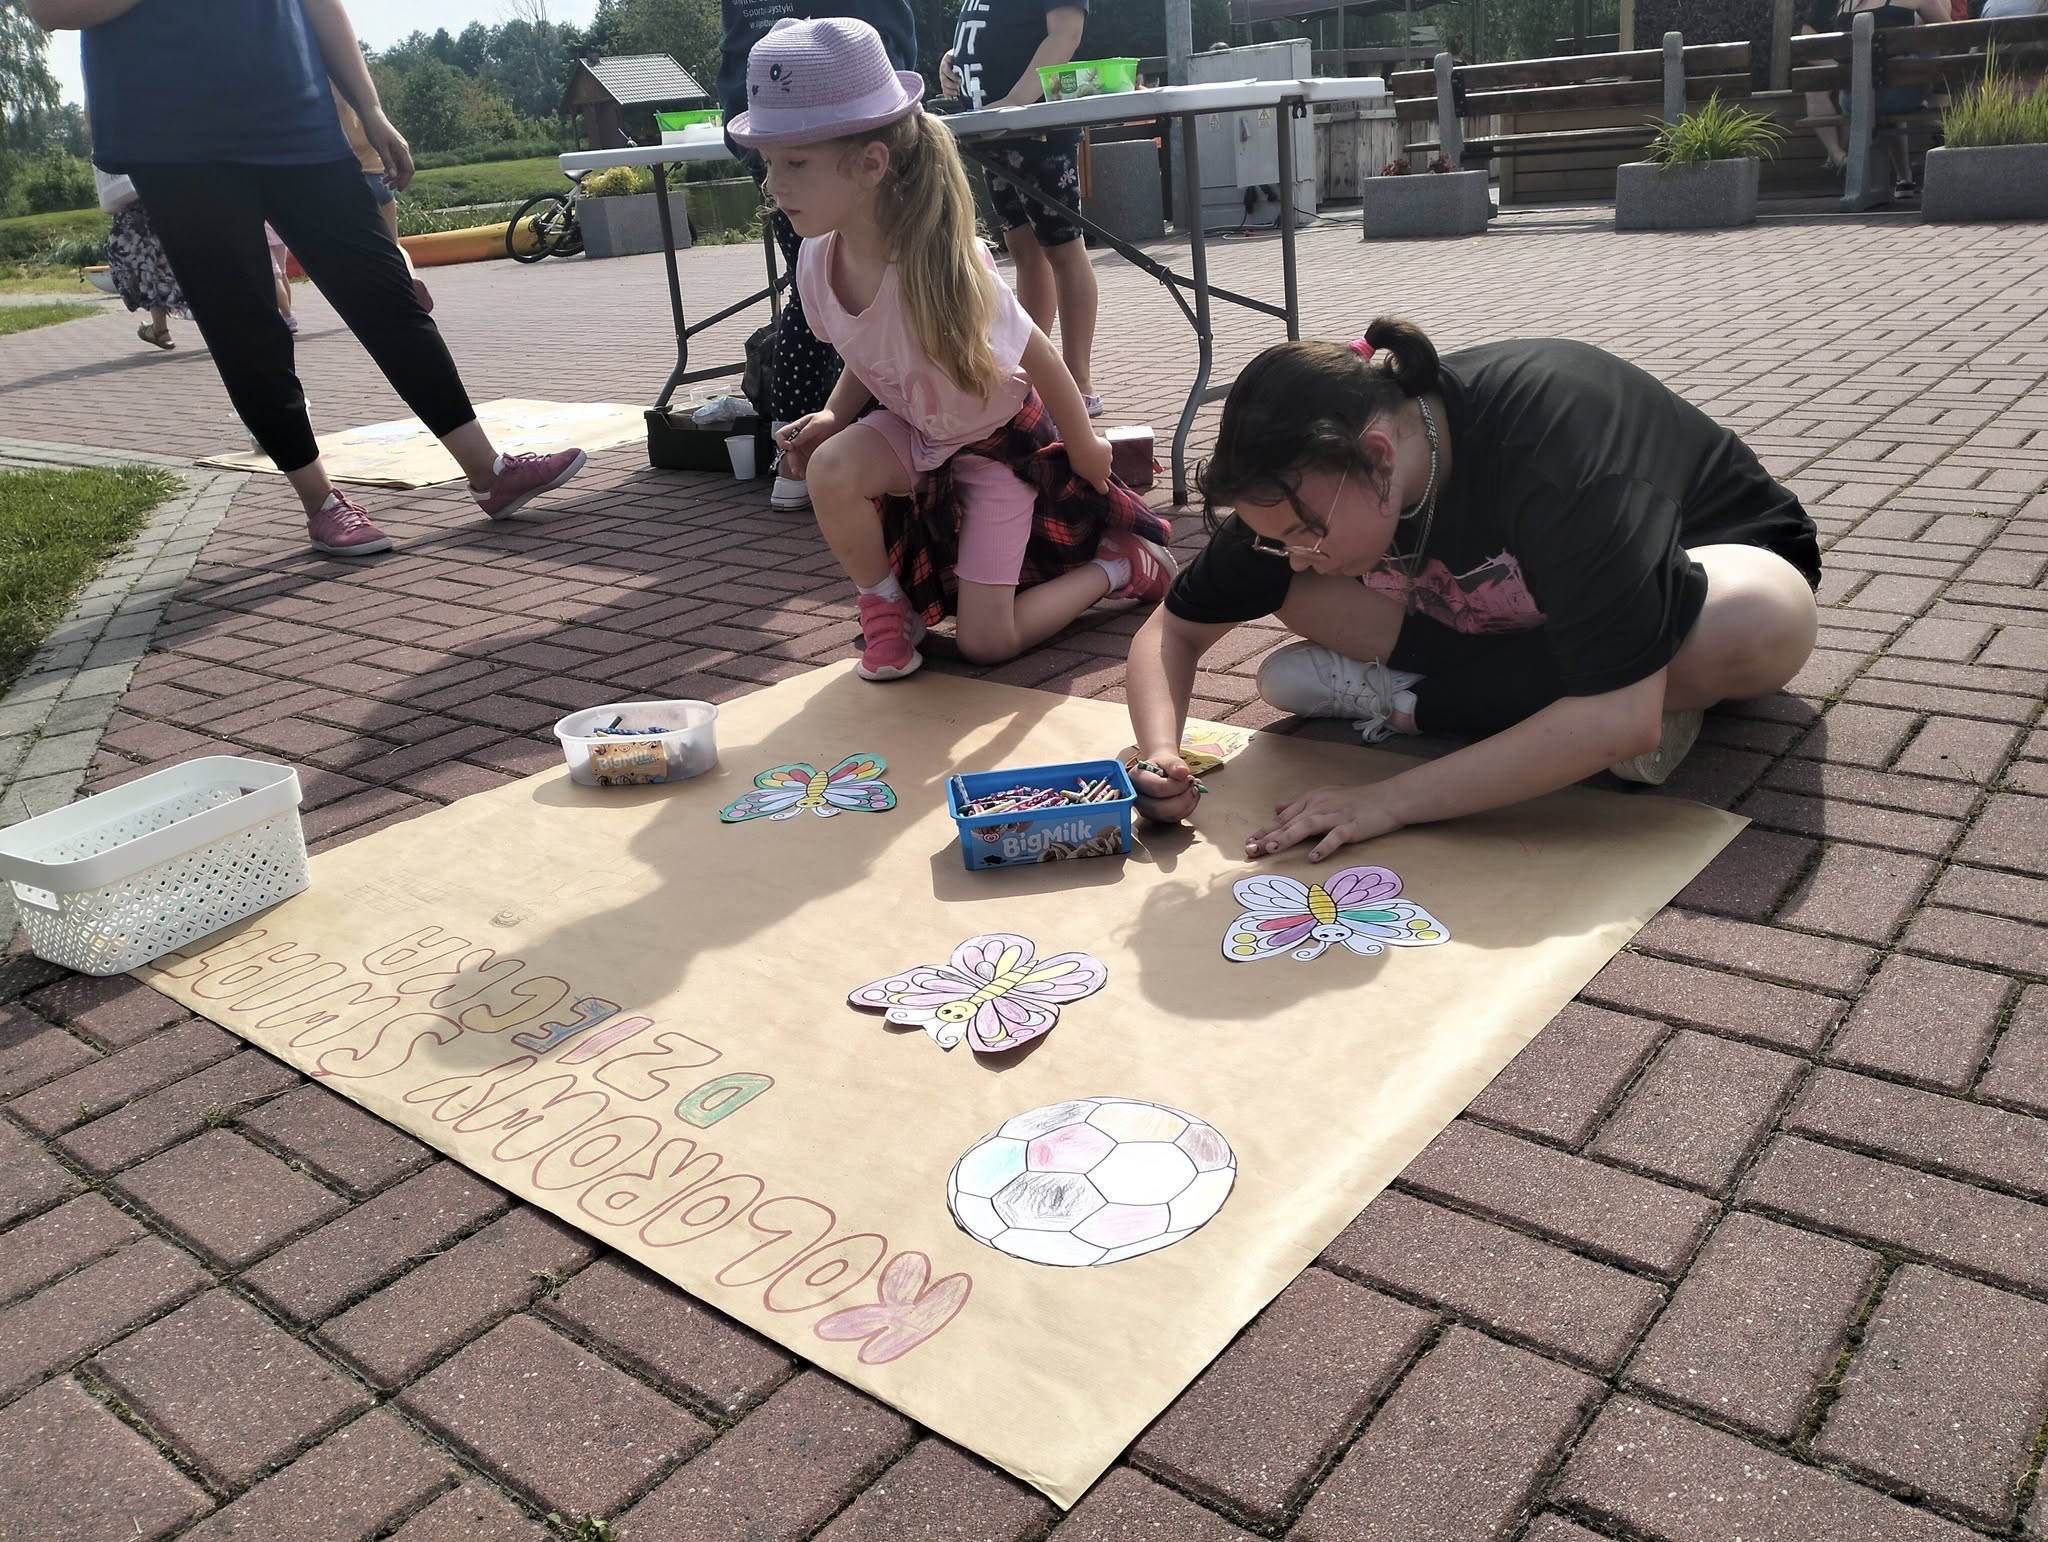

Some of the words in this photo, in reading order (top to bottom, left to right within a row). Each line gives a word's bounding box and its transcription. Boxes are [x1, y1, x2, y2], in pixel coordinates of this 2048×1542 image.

[1002, 819, 1093, 858] BigMilk
[362, 925, 775, 1129] DZIECKA
[402, 1055, 973, 1365] KOLOROWY
